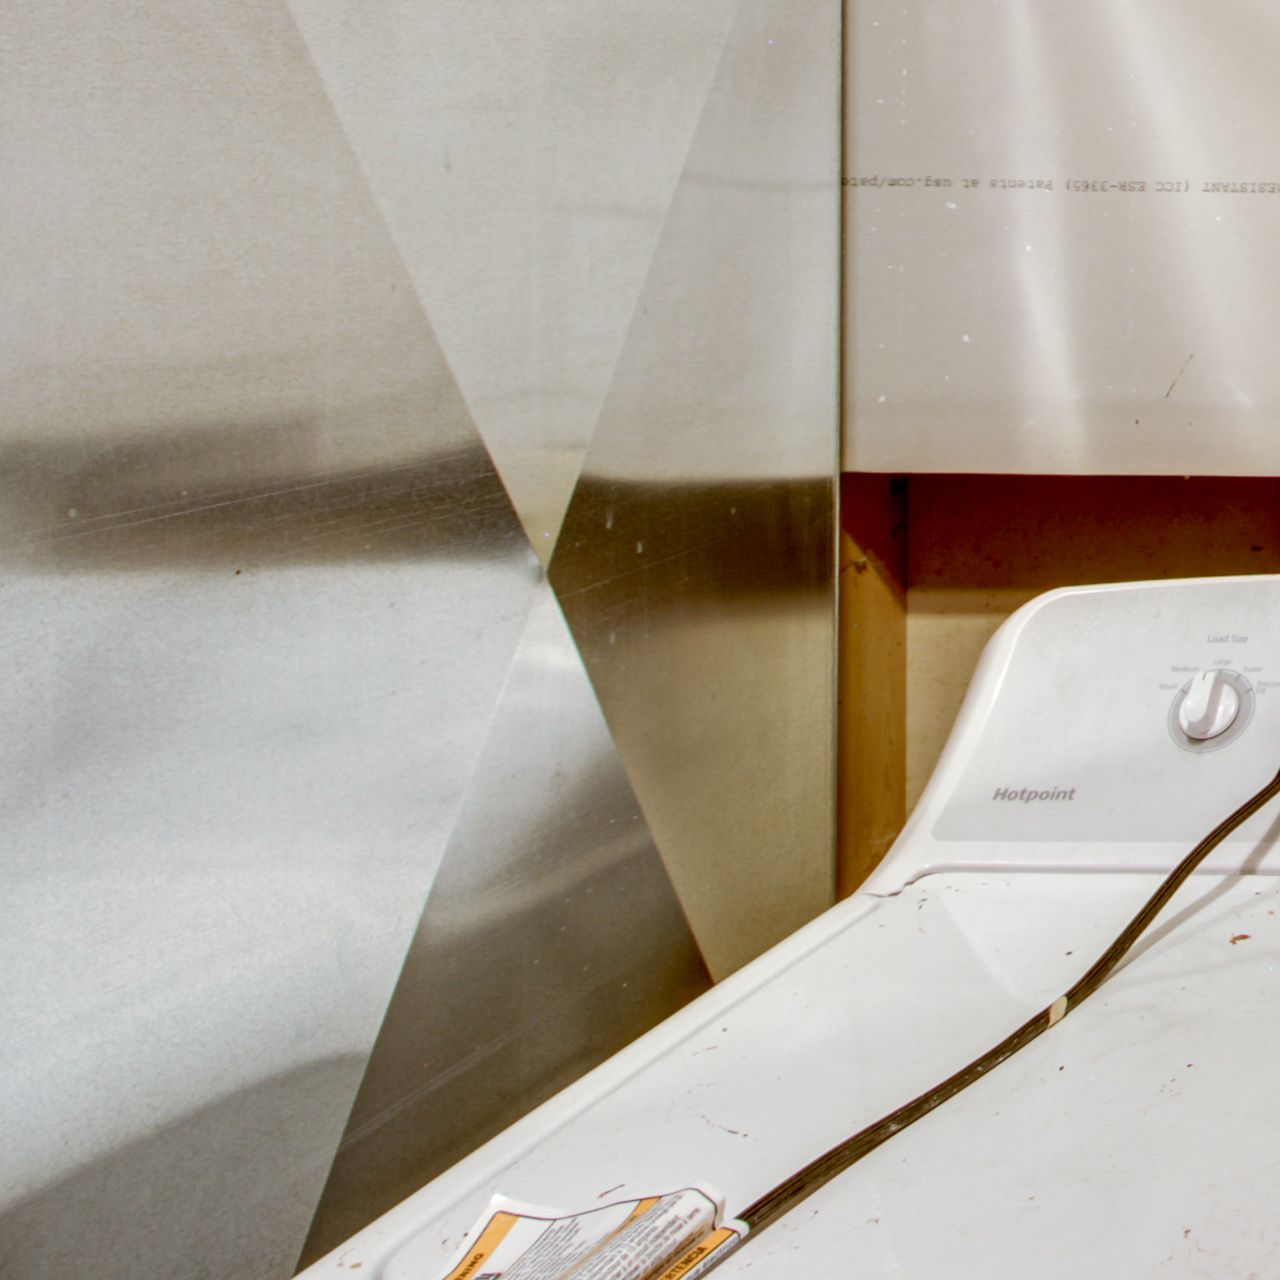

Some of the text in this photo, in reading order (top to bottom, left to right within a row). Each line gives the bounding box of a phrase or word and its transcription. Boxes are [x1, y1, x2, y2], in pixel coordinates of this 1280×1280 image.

[962, 178, 980, 190] at
[989, 178, 1053, 191] Patents
[1065, 179, 1147, 193] ESR-3365)
[1154, 181, 1189, 193] (ICC
[1207, 634, 1249, 644] Load Size
[991, 786, 1077, 804] Hotpoint
